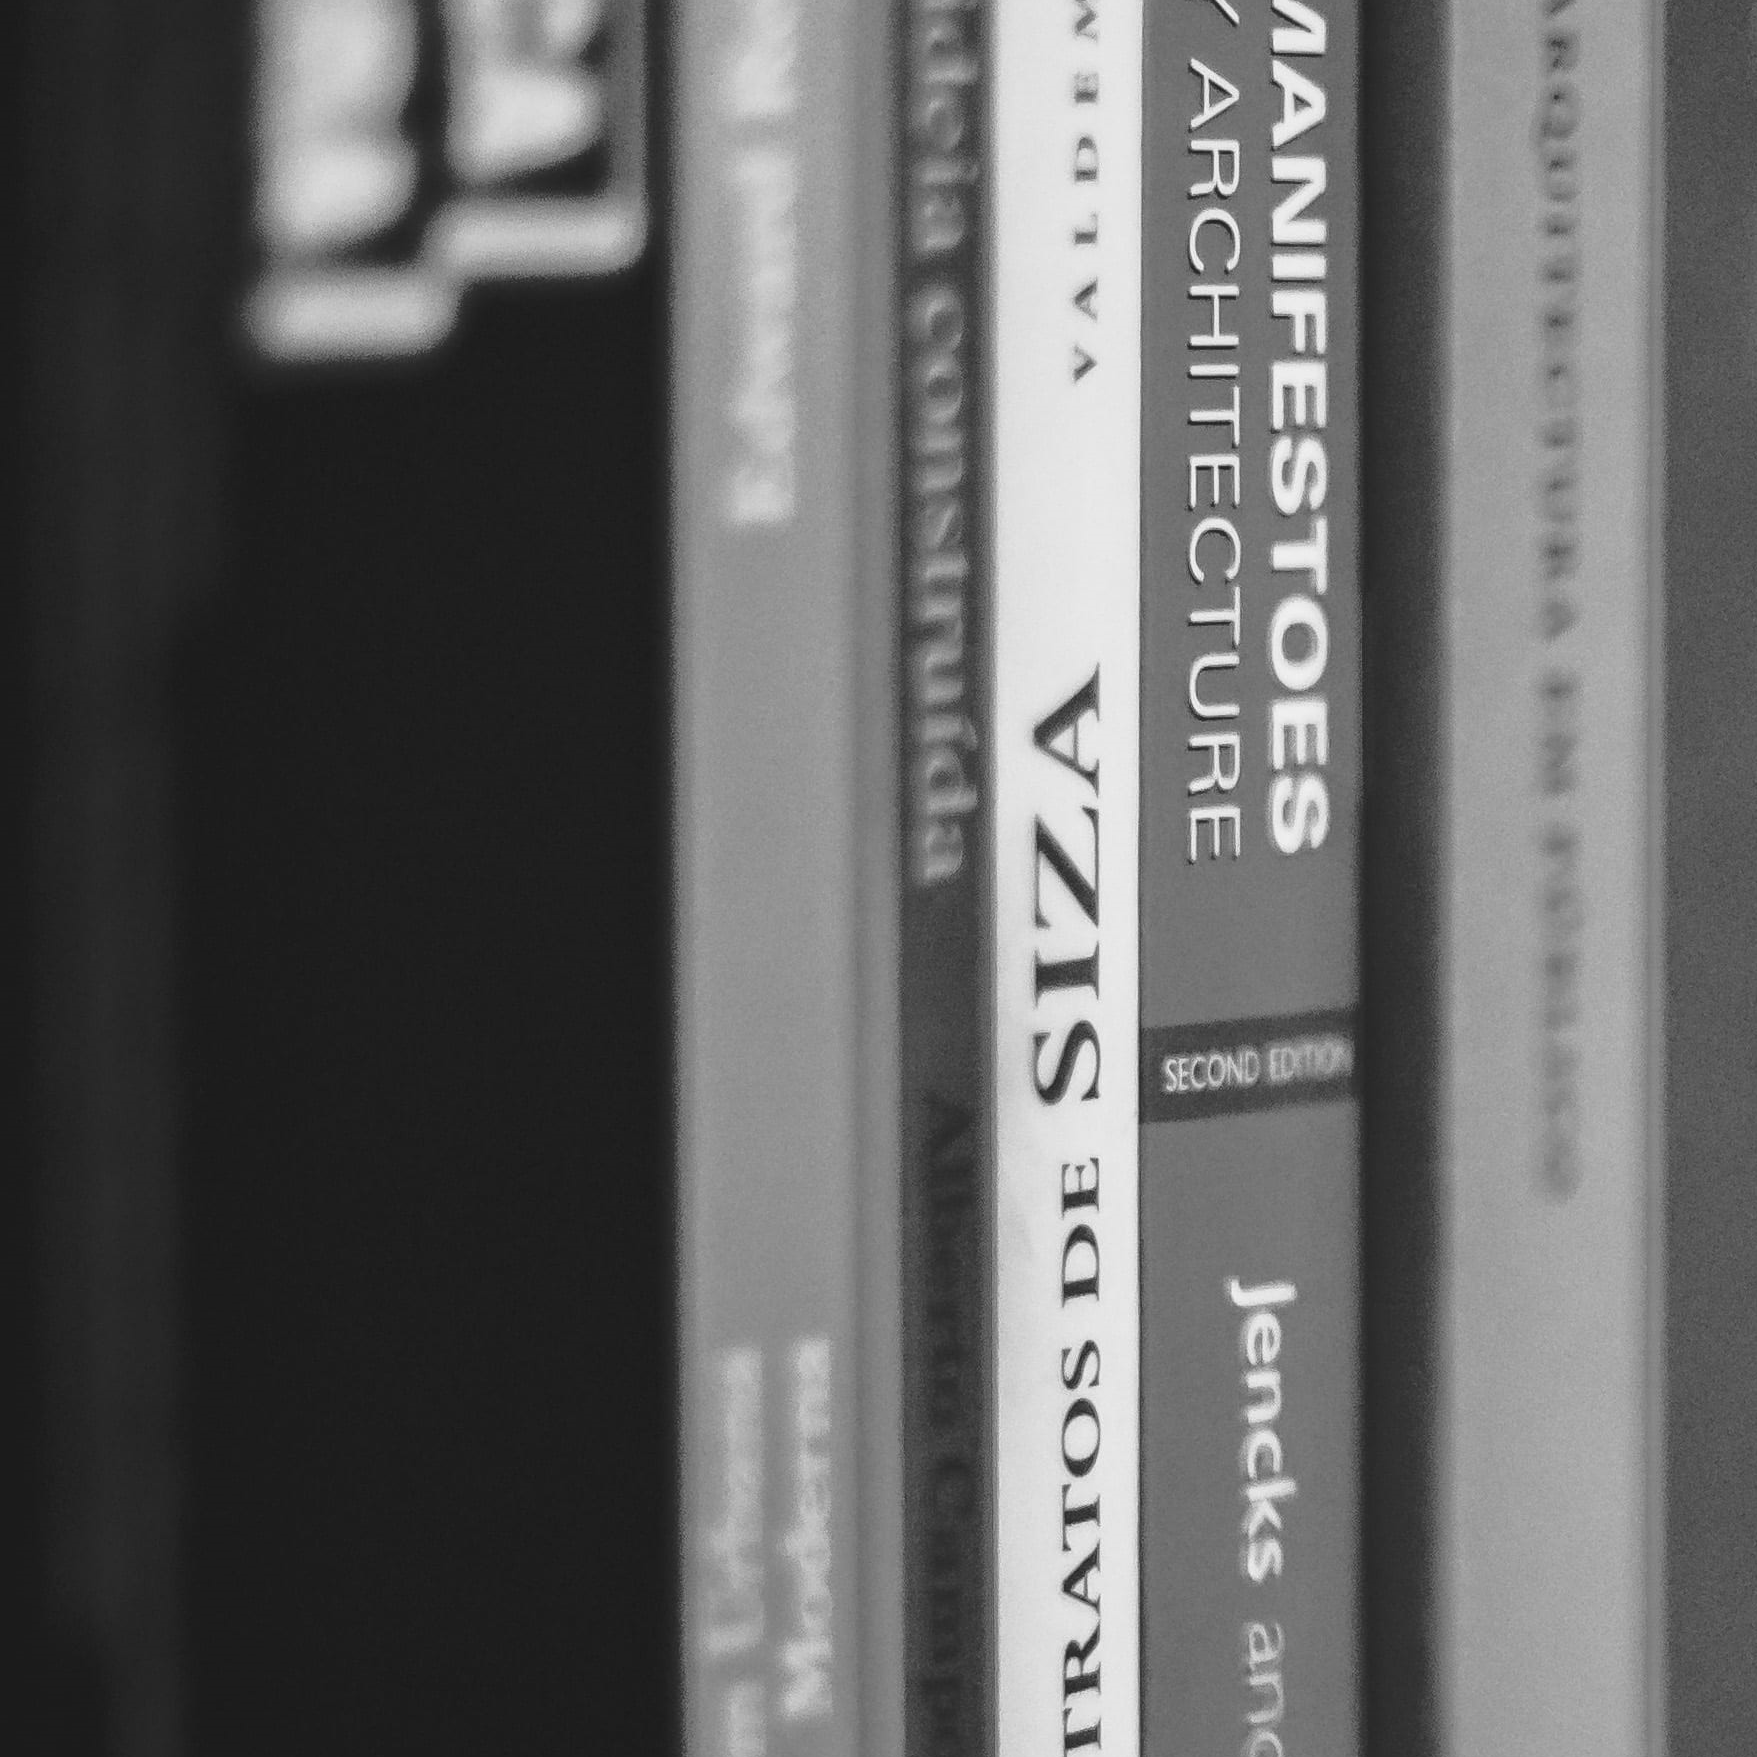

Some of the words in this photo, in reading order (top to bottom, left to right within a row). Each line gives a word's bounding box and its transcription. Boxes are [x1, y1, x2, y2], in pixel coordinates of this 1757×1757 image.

[1188, 60, 1242, 863] ARCHITECTURE
[1032, 661, 1102, 1104] SIZA
[1165, 1050, 1260, 1091] SECOND
[1060, 1157, 1103, 1301] DE
[1228, 1281, 1299, 1582] Jencks
